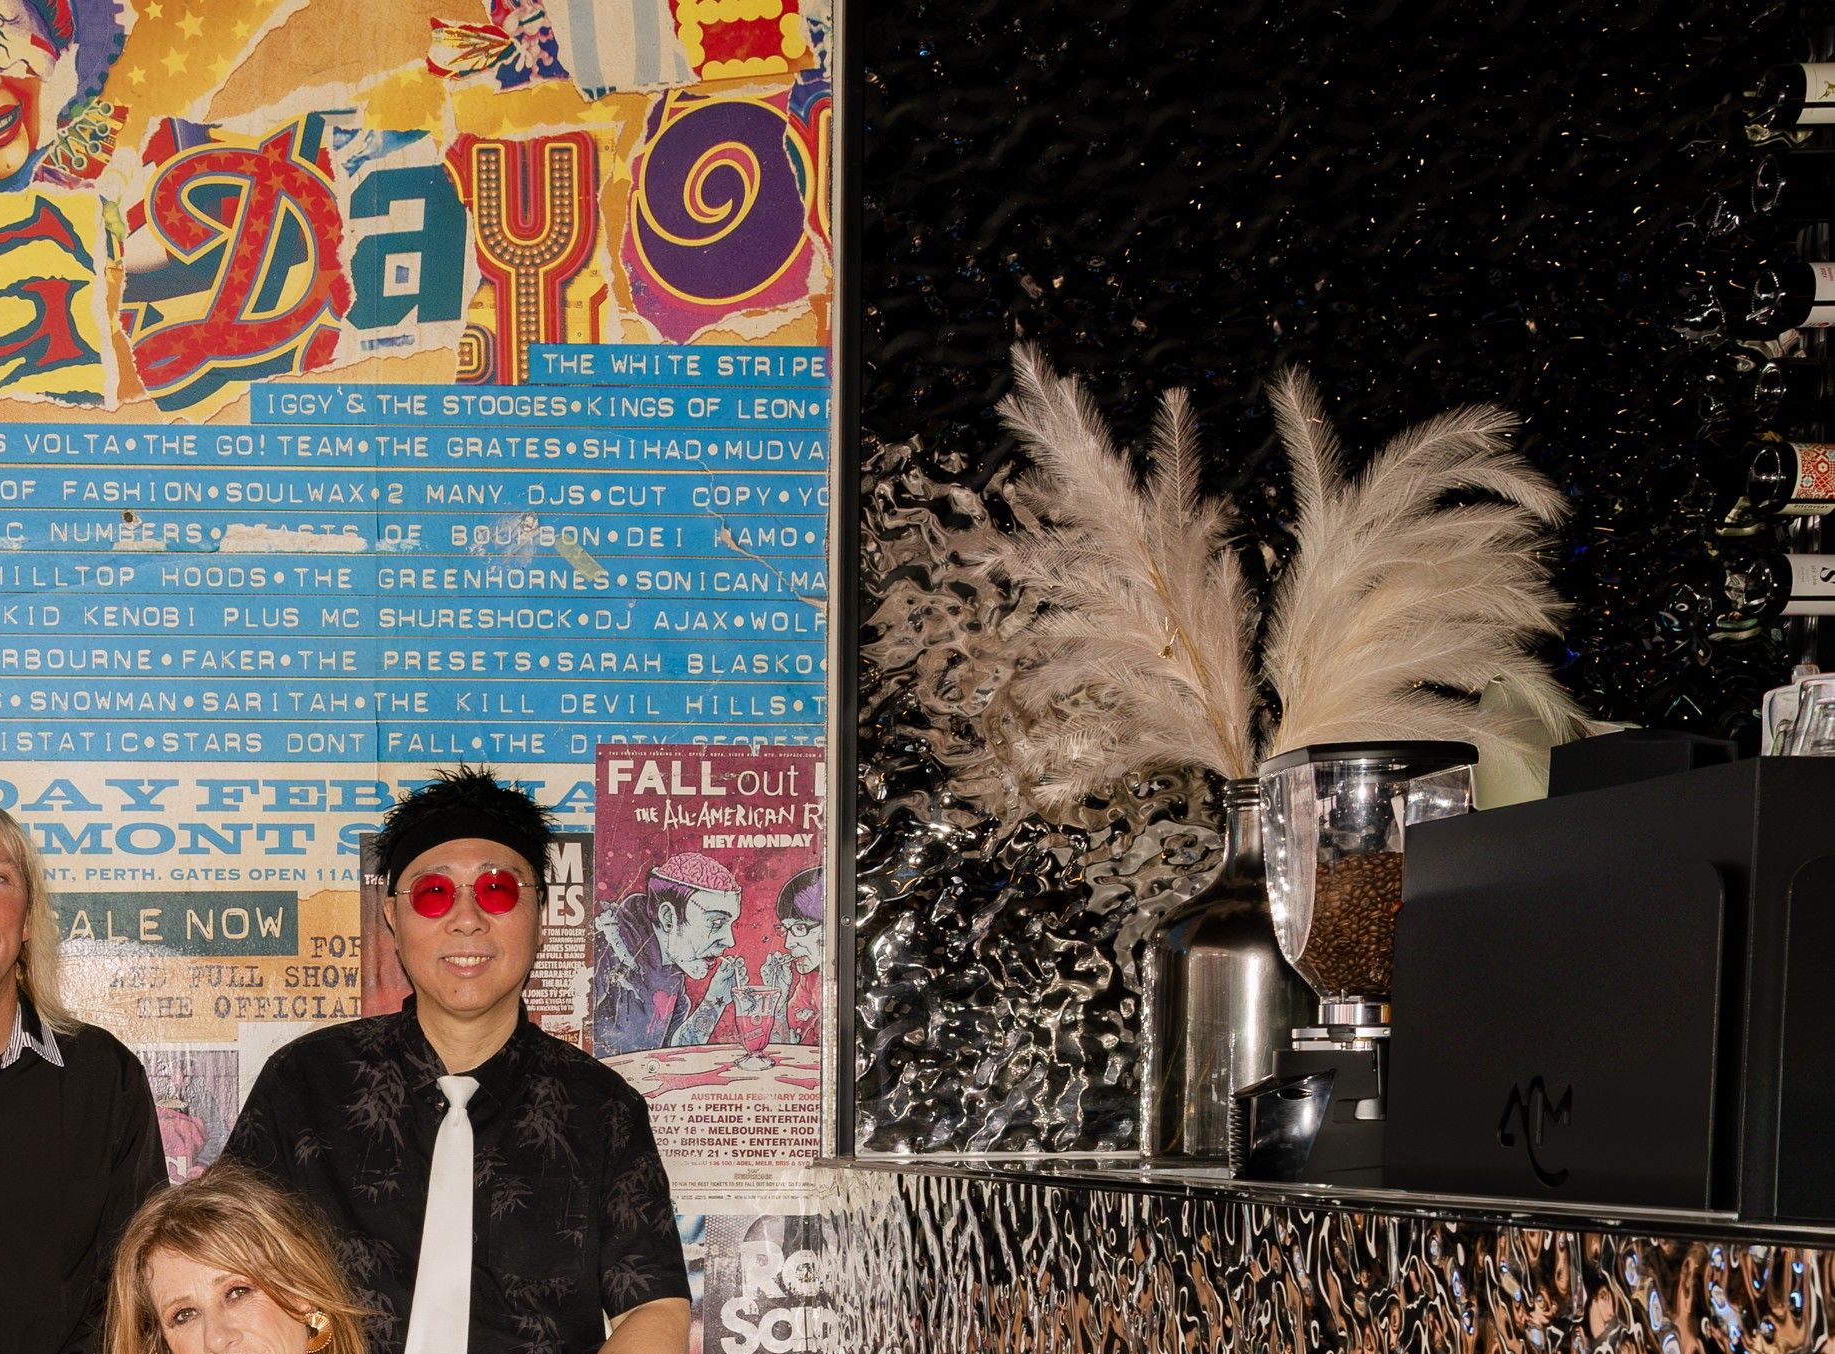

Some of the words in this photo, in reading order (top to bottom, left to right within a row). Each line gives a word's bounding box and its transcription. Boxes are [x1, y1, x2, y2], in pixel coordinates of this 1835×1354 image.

[542, 353, 593, 376] THE
[612, 354, 700, 377] WHITE
[268, 394, 333, 416] IGGY
[346, 394, 367, 416] &
[377, 395, 427, 416] THE
[687, 397, 721, 419] OF
[737, 398, 806, 419] LEON
[25, 432, 121, 455] VOLTA
[447, 436, 564, 459] GRATES
[427, 482, 503, 505] MANY
[528, 484, 585, 506] DJS
[378, 608, 572, 630] SHURESHOCK
[557, 651, 661, 674] SARAH
[686, 653, 813, 675] BLASKO
[608, 759, 726, 795] FALL
[737, 764, 799, 796] out
[634, 806, 658, 823] THE
[703, 834, 735, 849] HEY
[737, 834, 814, 848] MONDAY
[86, 868, 162, 881] PERTH.
[170, 868, 241, 881] GATES
[249, 868, 306, 881] OPEN
[688, 1115, 744, 1123] ADELAIDE
[708, 1126, 779, 1135] MELBOURNE
[681, 1138, 738, 1146] BRISBANE
[732, 1150, 777, 1158] SYDNEY
